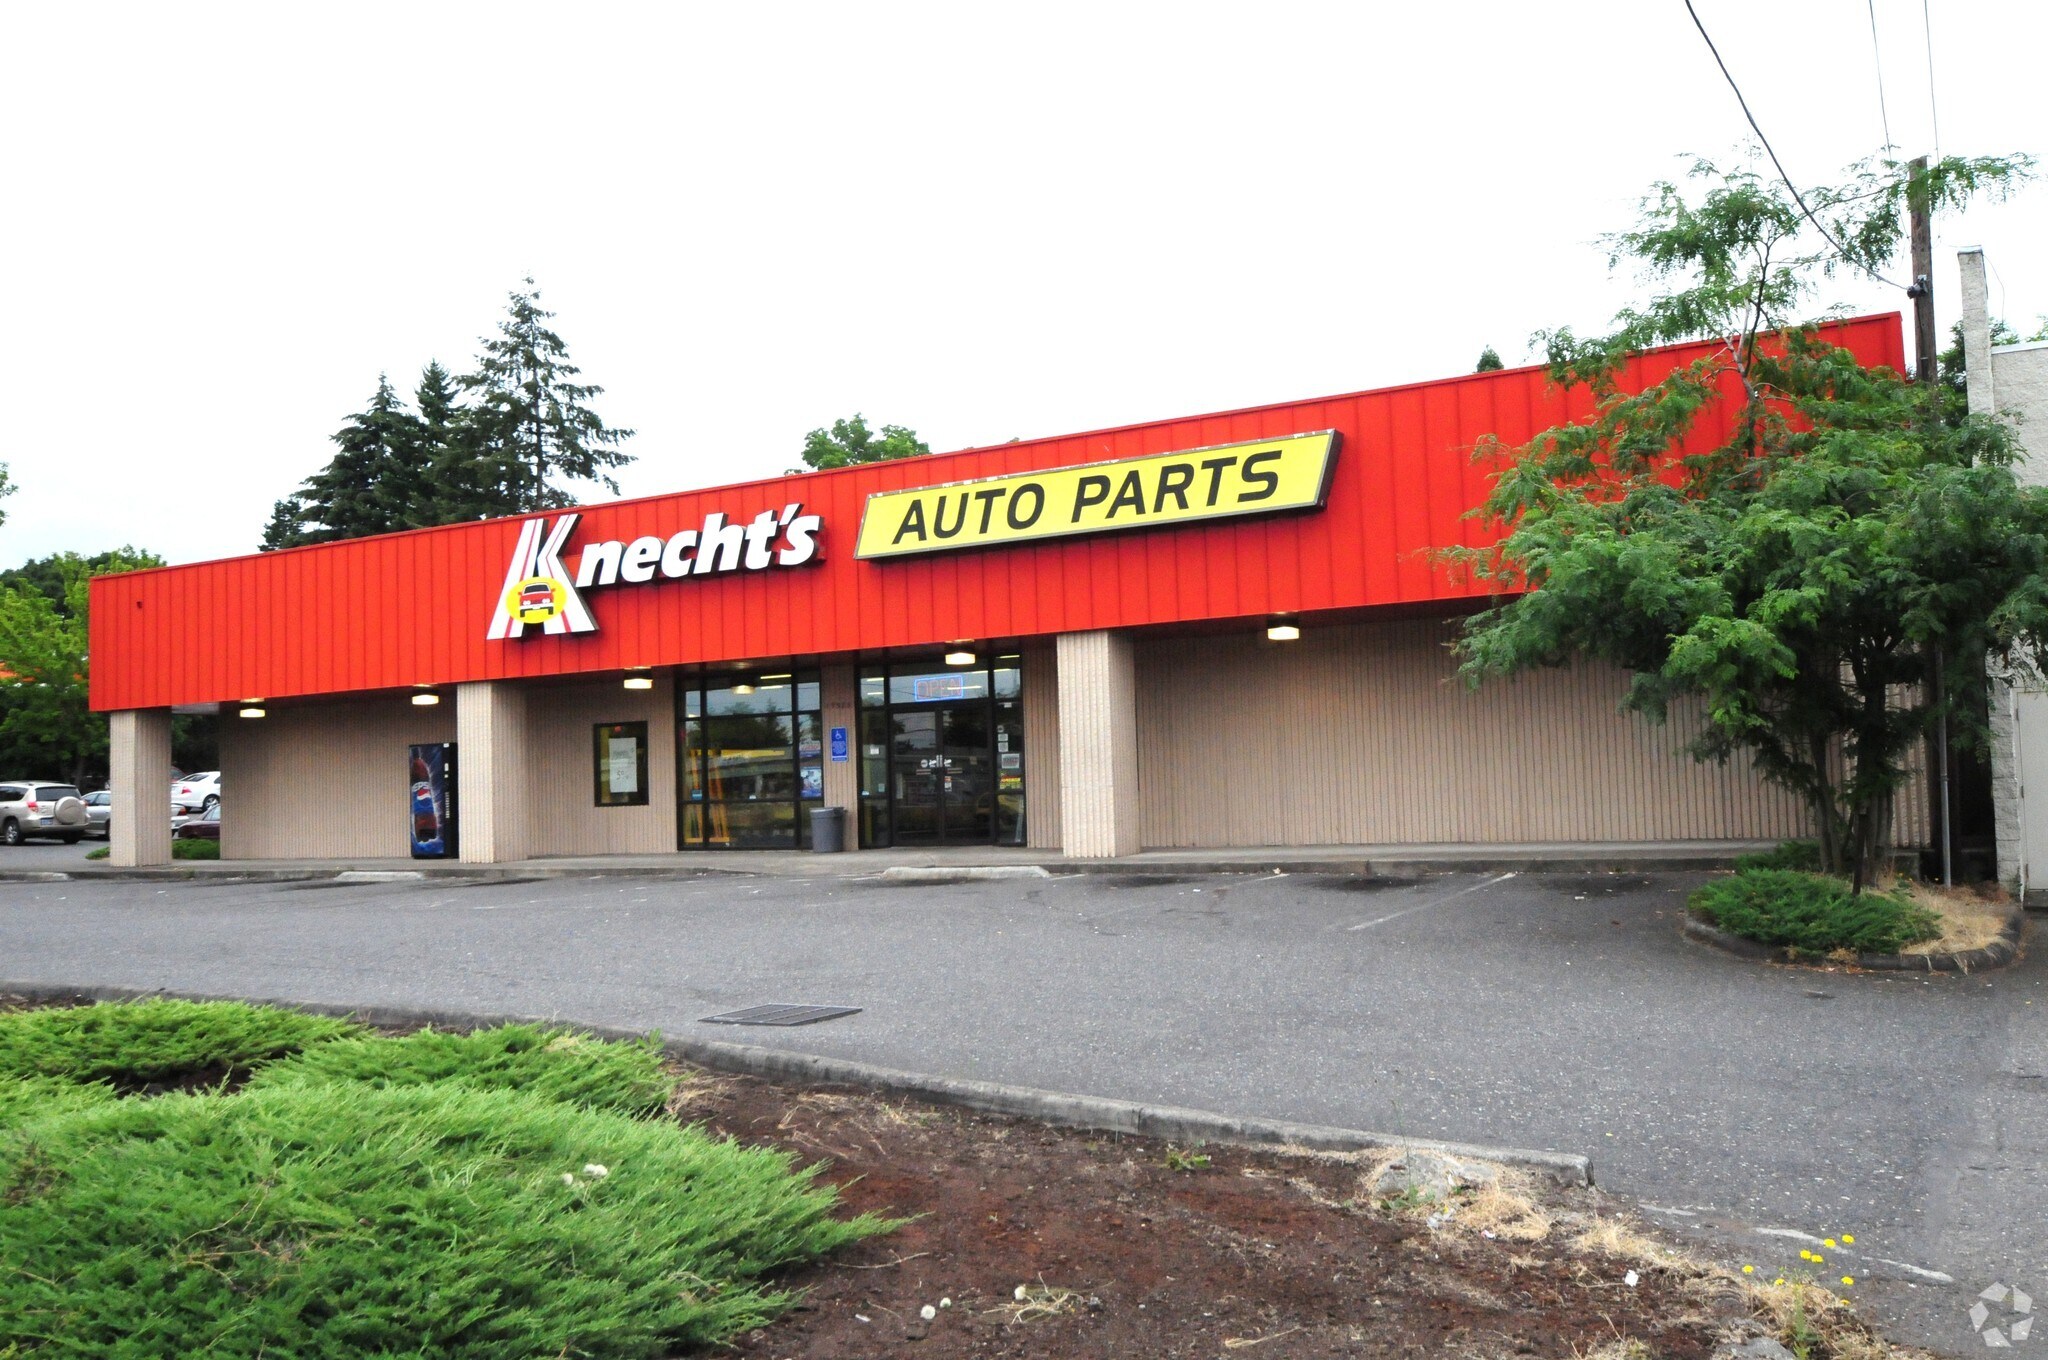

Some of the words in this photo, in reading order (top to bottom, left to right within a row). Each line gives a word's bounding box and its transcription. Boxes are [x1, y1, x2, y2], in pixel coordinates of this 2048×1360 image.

[891, 482, 1045, 545] AUTO
[1070, 450, 1283, 524] PARTS
[486, 503, 822, 640] Knecht's
[917, 678, 962, 698] OPEN
